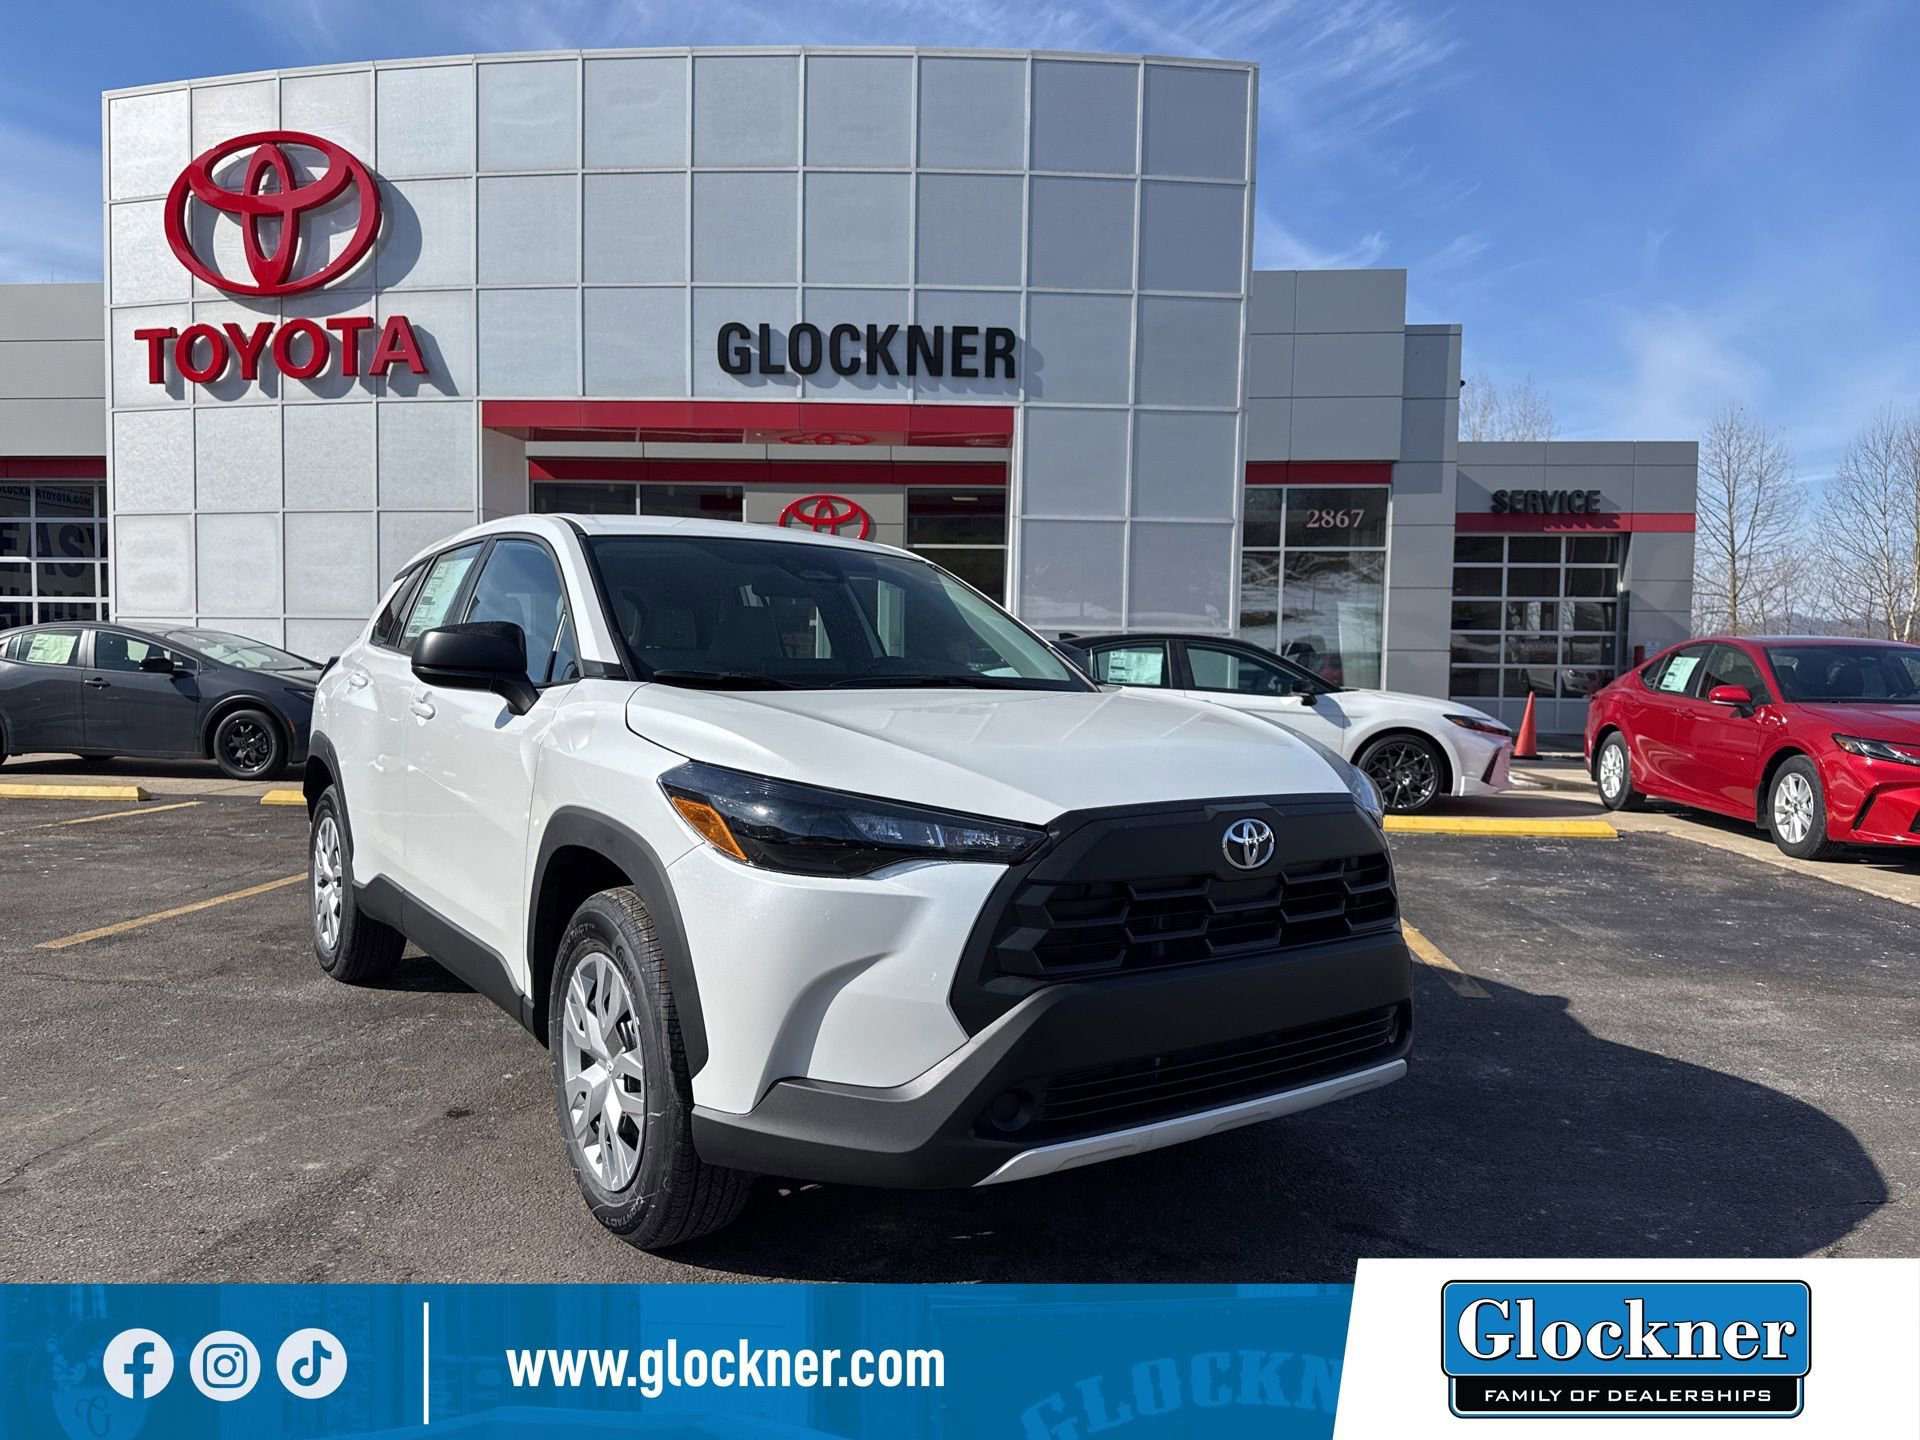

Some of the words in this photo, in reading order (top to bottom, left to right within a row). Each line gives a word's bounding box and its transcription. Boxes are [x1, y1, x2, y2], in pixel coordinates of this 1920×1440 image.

[134, 315, 428, 384] TOYOTA
[717, 322, 1016, 378] GLOCKNER
[1306, 508, 1365, 529] 2867
[1491, 490, 1601, 514] SERVICE
